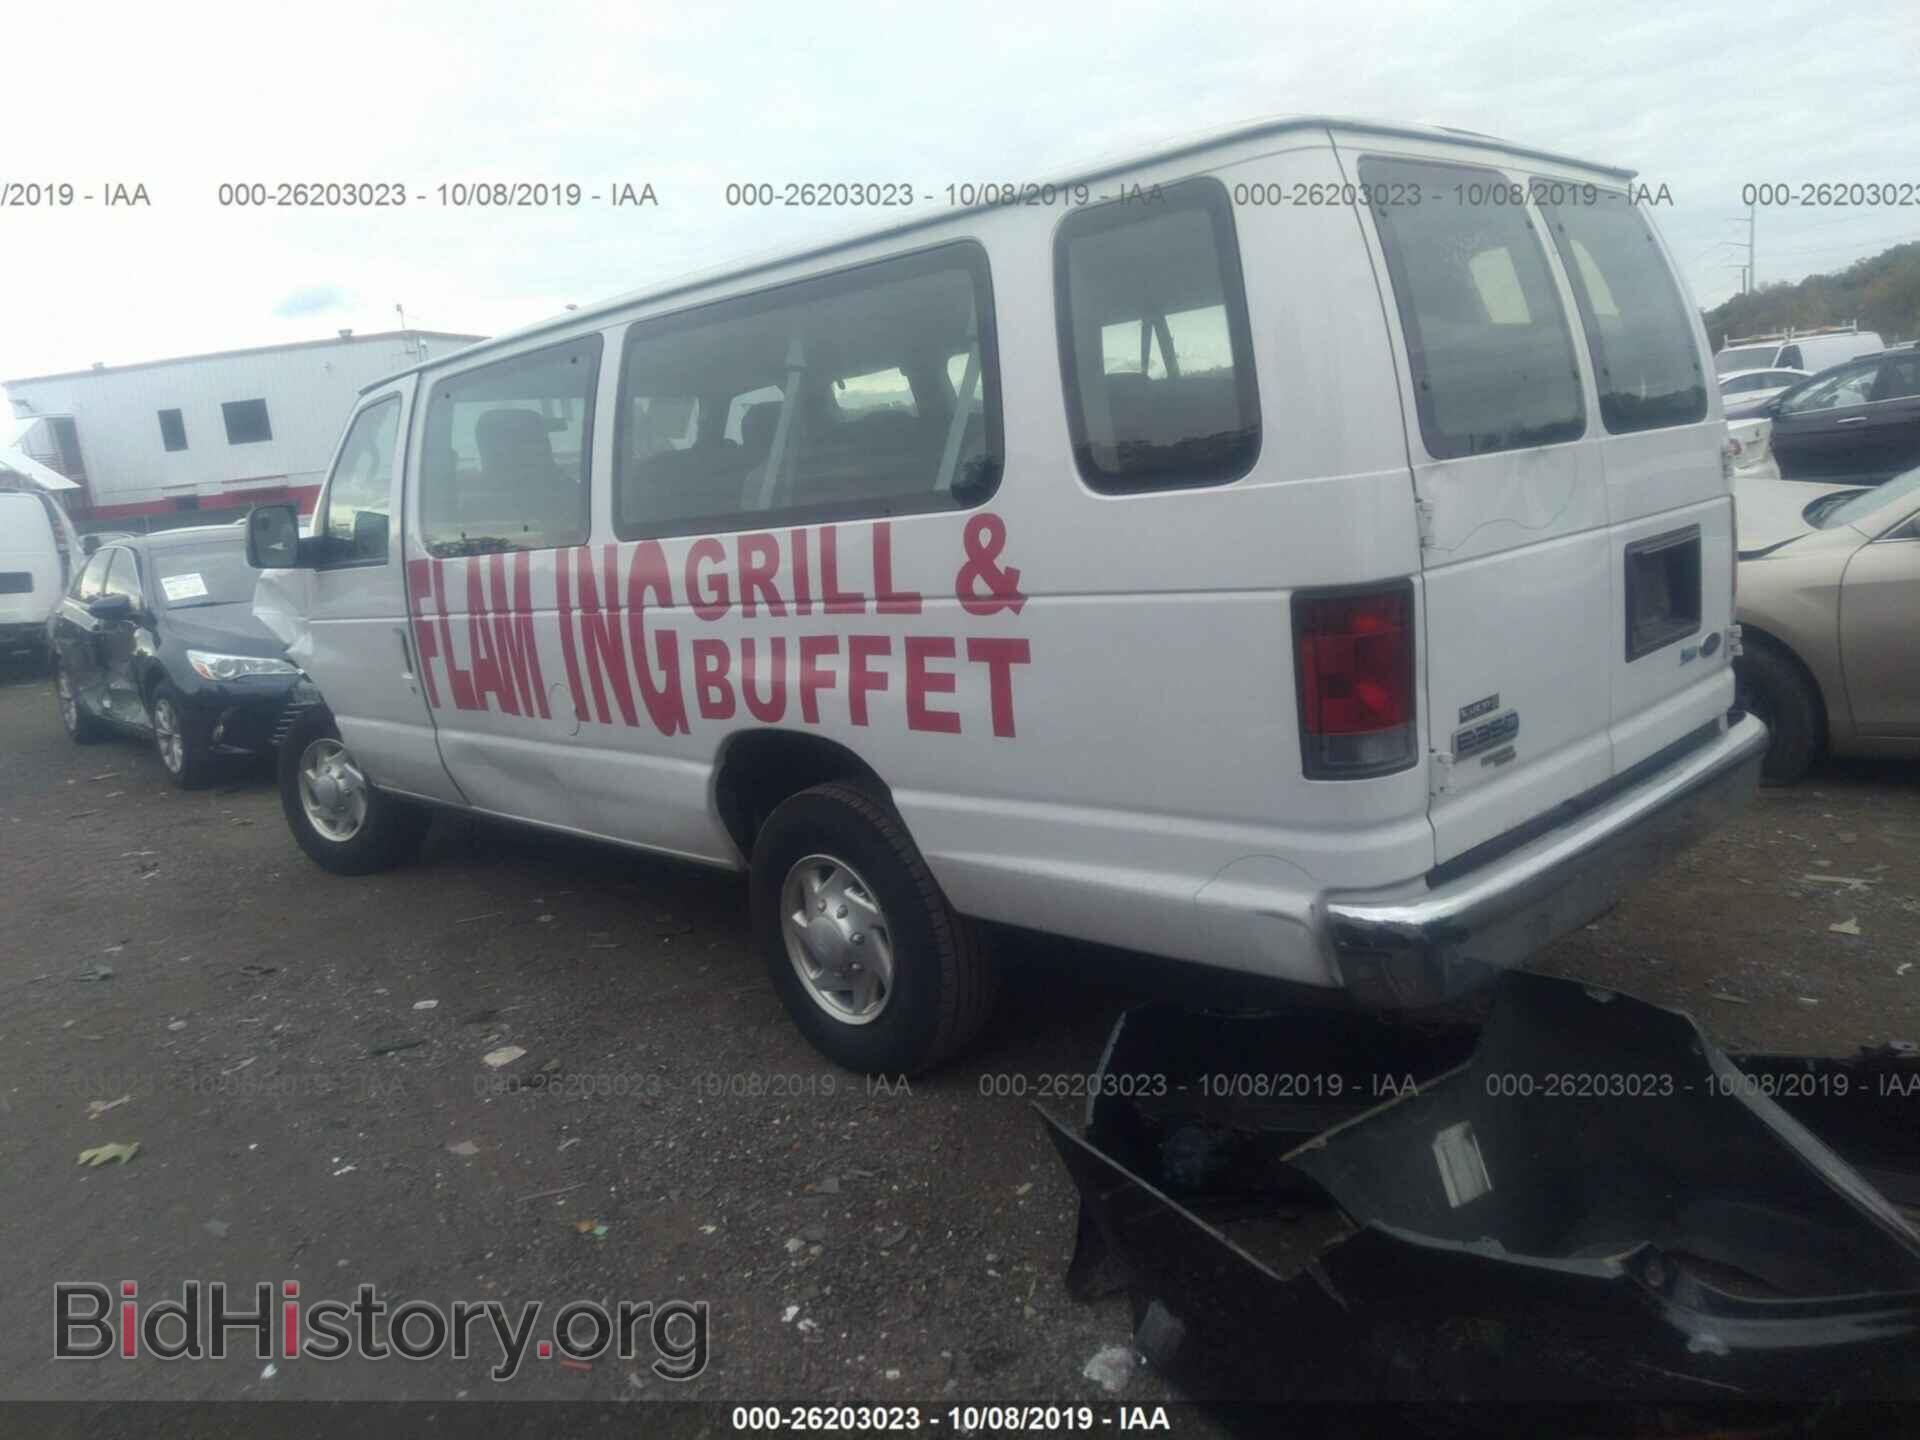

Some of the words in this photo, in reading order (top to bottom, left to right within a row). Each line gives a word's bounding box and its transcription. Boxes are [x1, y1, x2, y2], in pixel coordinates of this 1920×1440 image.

[408, 540, 691, 737] FLAMING
[685, 522, 922, 621] GRILL
[955, 512, 1028, 616] &
[693, 634, 1031, 738] BUFFET
